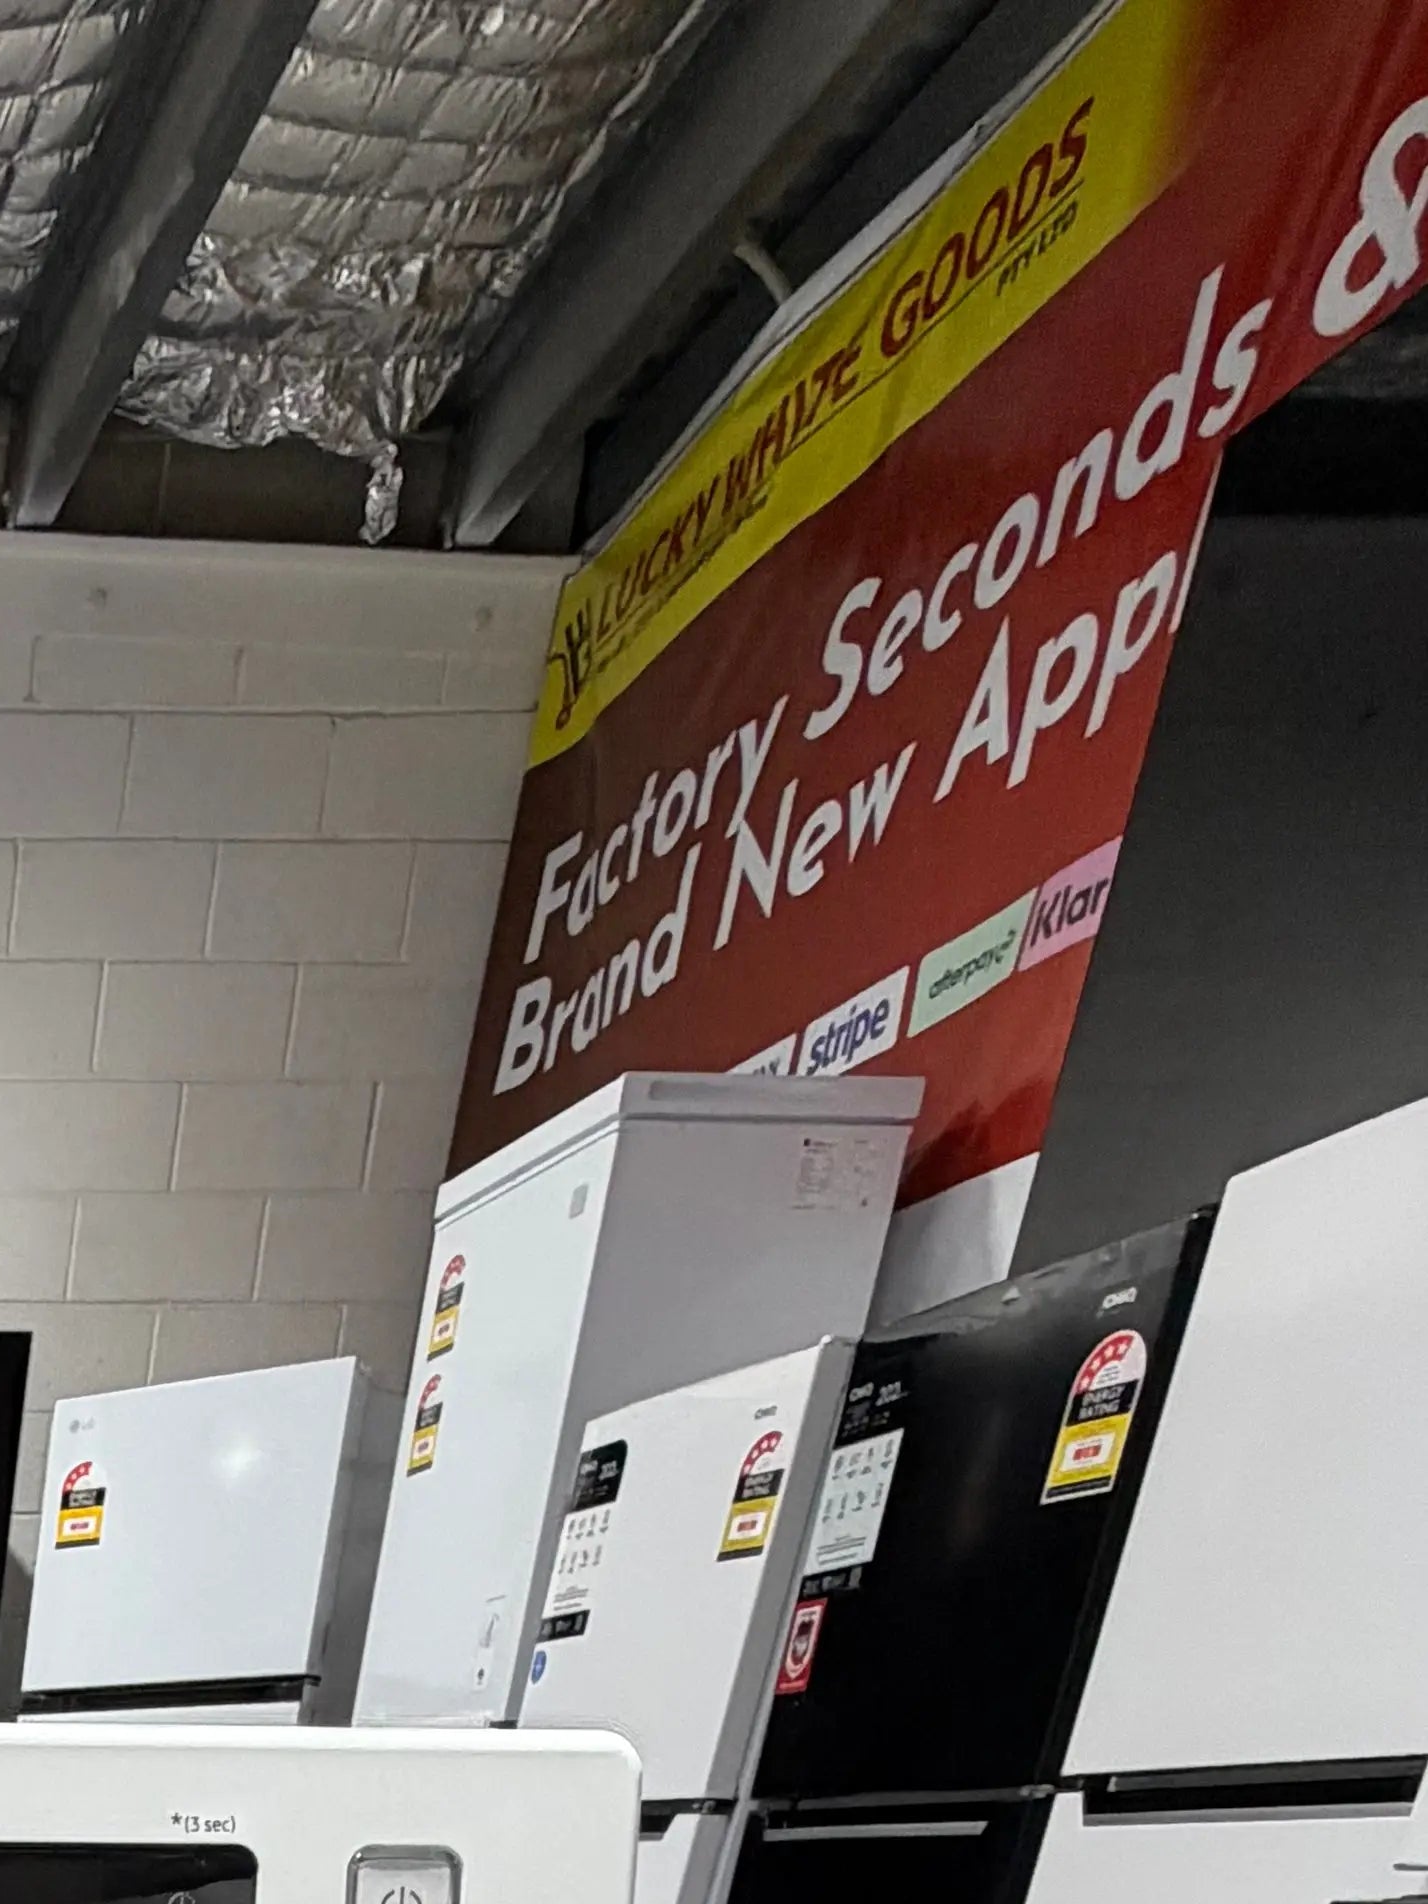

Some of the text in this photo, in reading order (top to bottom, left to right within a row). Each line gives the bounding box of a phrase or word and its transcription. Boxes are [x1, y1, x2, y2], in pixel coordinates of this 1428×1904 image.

[597, 475, 721, 637] LUCKY
[880, 96, 1094, 358] GOODS
[523, 695, 789, 964] Factory
[803, 263, 1274, 740] Seconds
[493, 842, 701, 1096] Brand
[713, 740, 918, 951] New
[807, 998, 890, 1075] stripe
[204, 1816, 237, 1834] sec)
